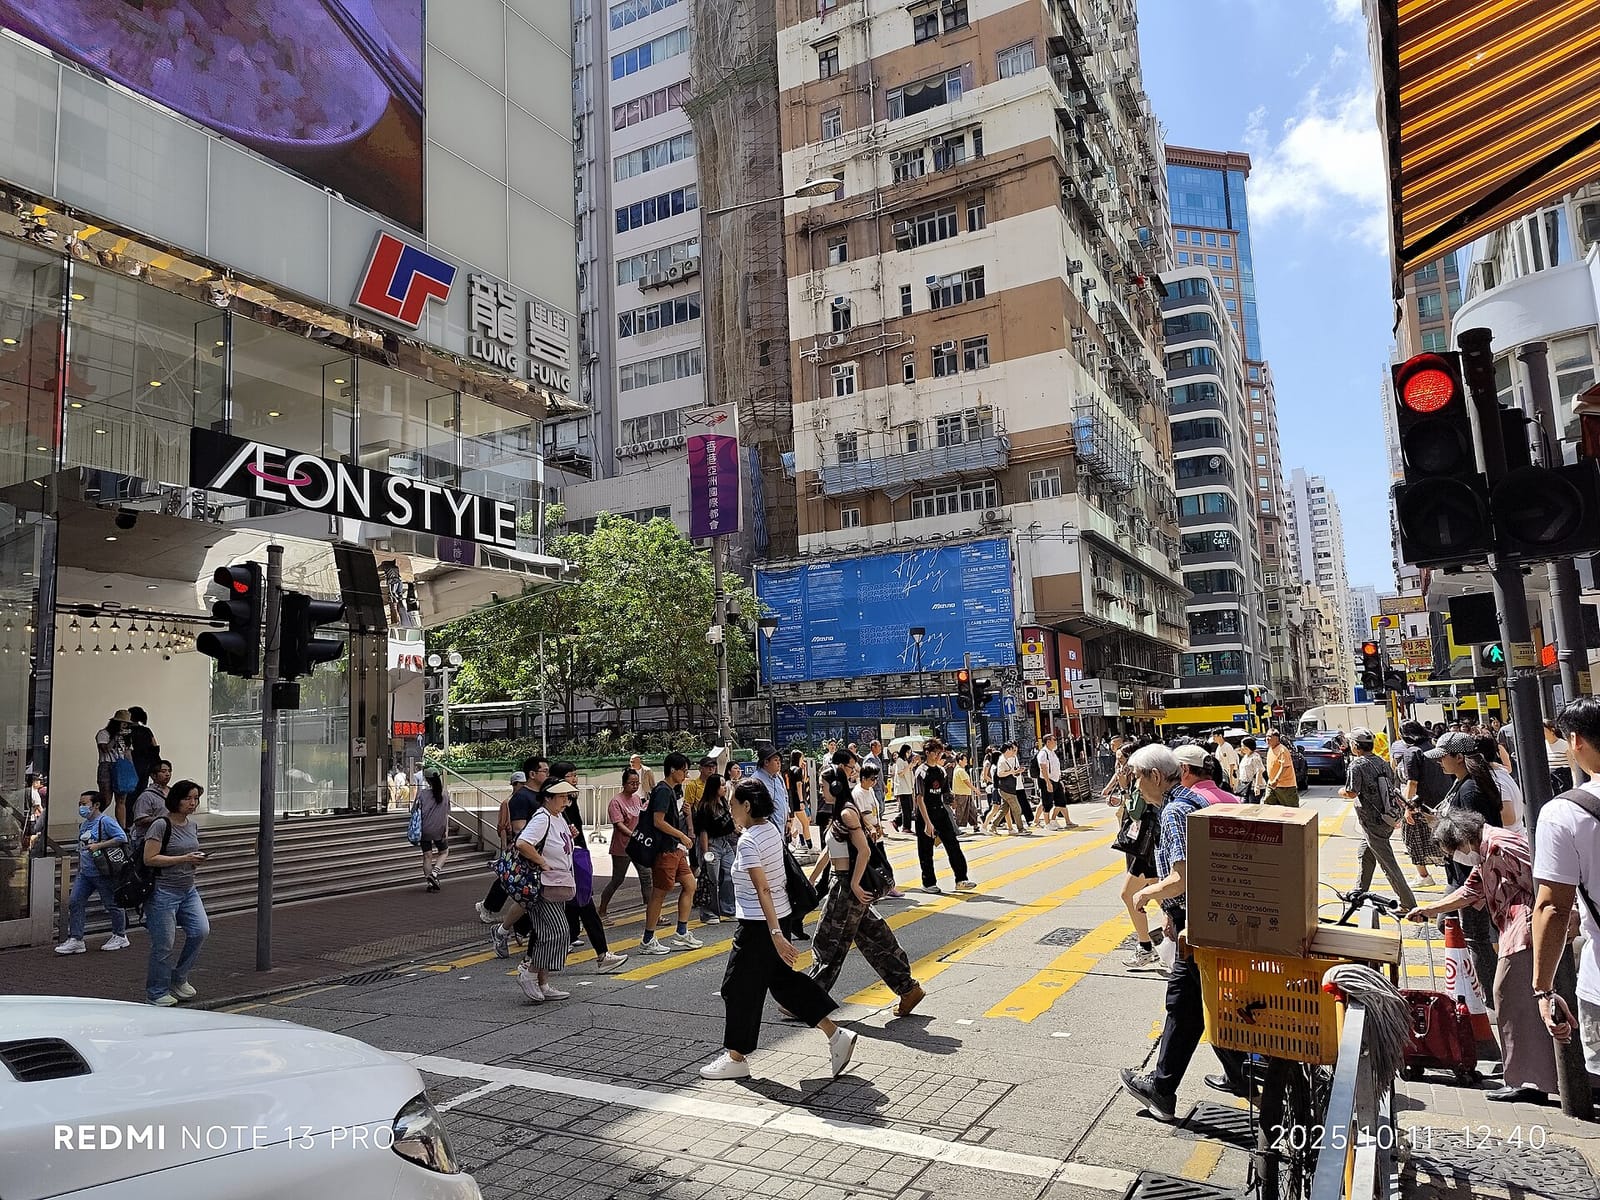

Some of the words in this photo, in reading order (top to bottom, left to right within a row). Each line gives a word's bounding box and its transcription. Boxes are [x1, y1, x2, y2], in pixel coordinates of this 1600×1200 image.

[469, 337, 518, 372] LUNG
[528, 361, 571, 393] FUNG
[385, 476, 516, 546] STYLE
[1243, 891, 1256, 899] PCS
